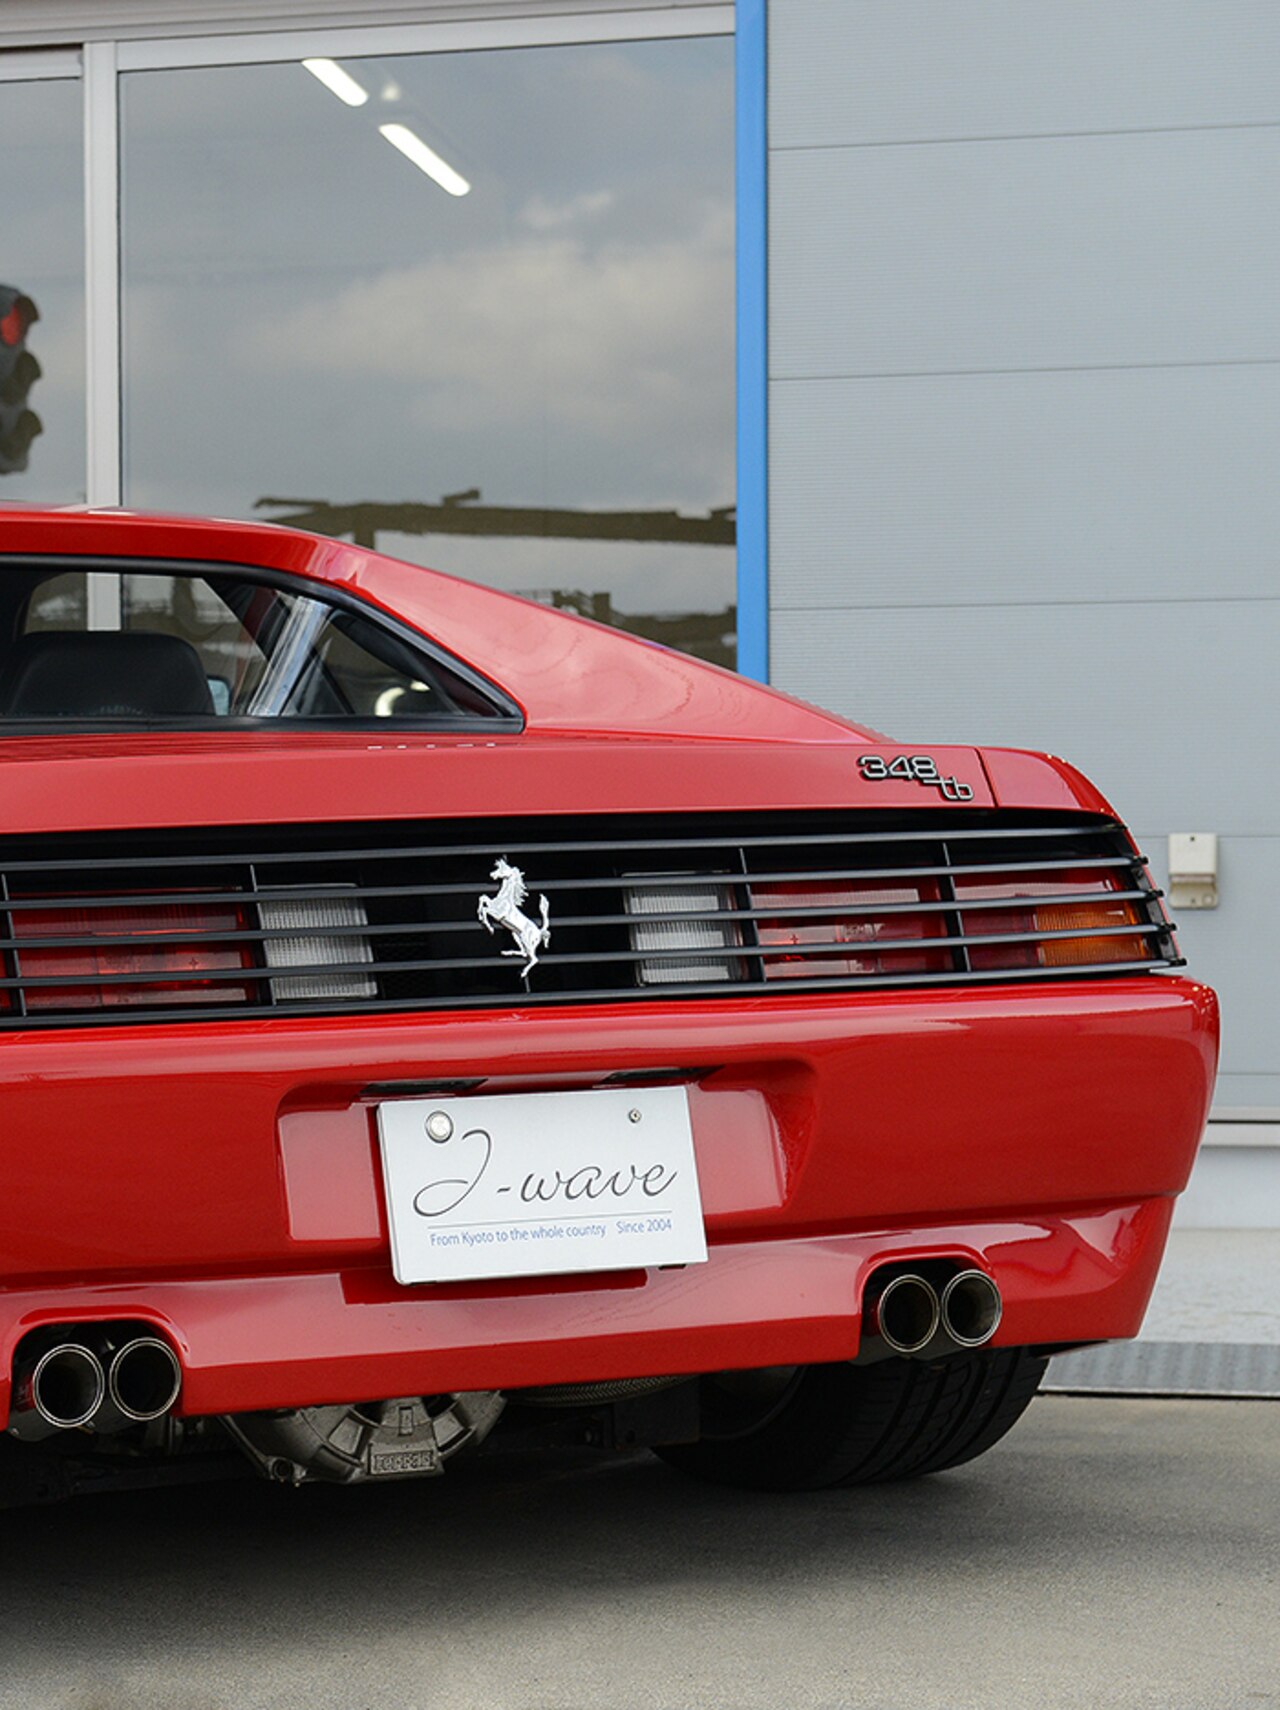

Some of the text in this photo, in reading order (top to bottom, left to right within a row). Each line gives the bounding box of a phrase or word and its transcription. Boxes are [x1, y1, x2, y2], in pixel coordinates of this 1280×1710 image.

[857, 755, 974, 800] 348 tb
[413, 1129, 678, 1217] J-wave
[430, 1218, 673, 1247] From Kyoto to the whole country Since 2004
